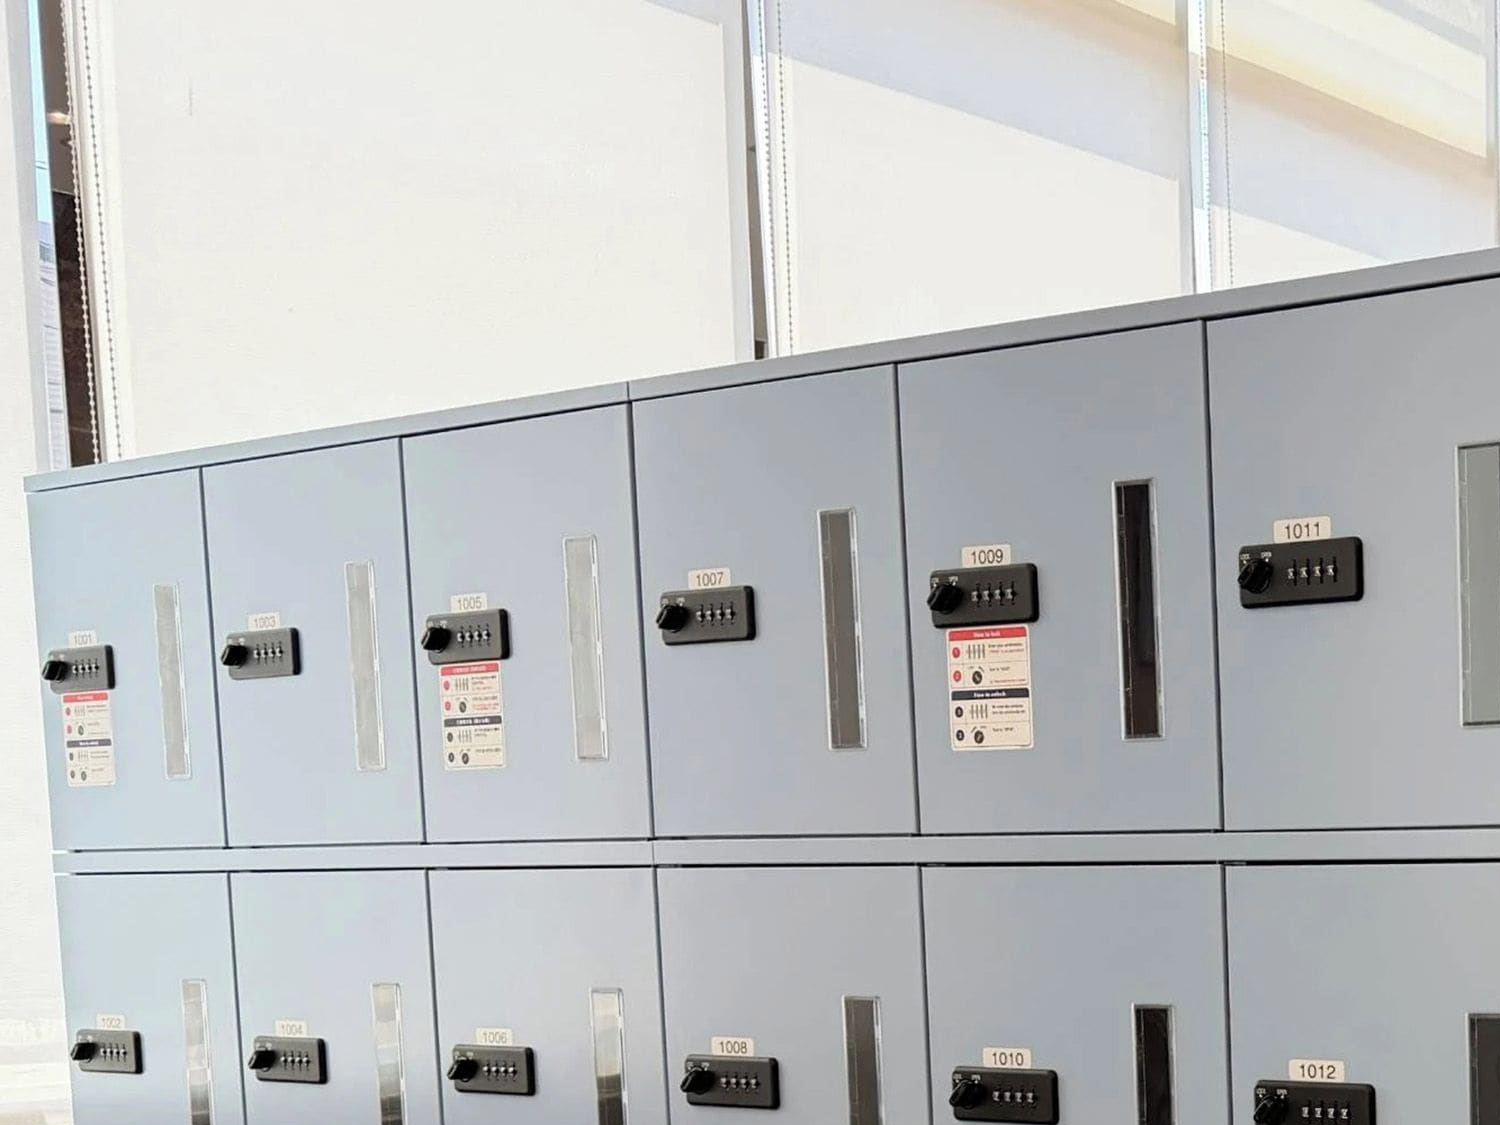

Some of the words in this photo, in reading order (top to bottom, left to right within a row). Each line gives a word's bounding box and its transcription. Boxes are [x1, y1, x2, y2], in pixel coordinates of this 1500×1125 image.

[1285, 522, 1320, 539] 1011
[971, 549, 1003, 565] 1009
[696, 571, 724, 587] 1007
[457, 596, 482, 610] 1005
[719, 1041, 748, 1055] 1008
[992, 1052, 1024, 1066] 1010
[1299, 1064, 1336, 1080] 1012
